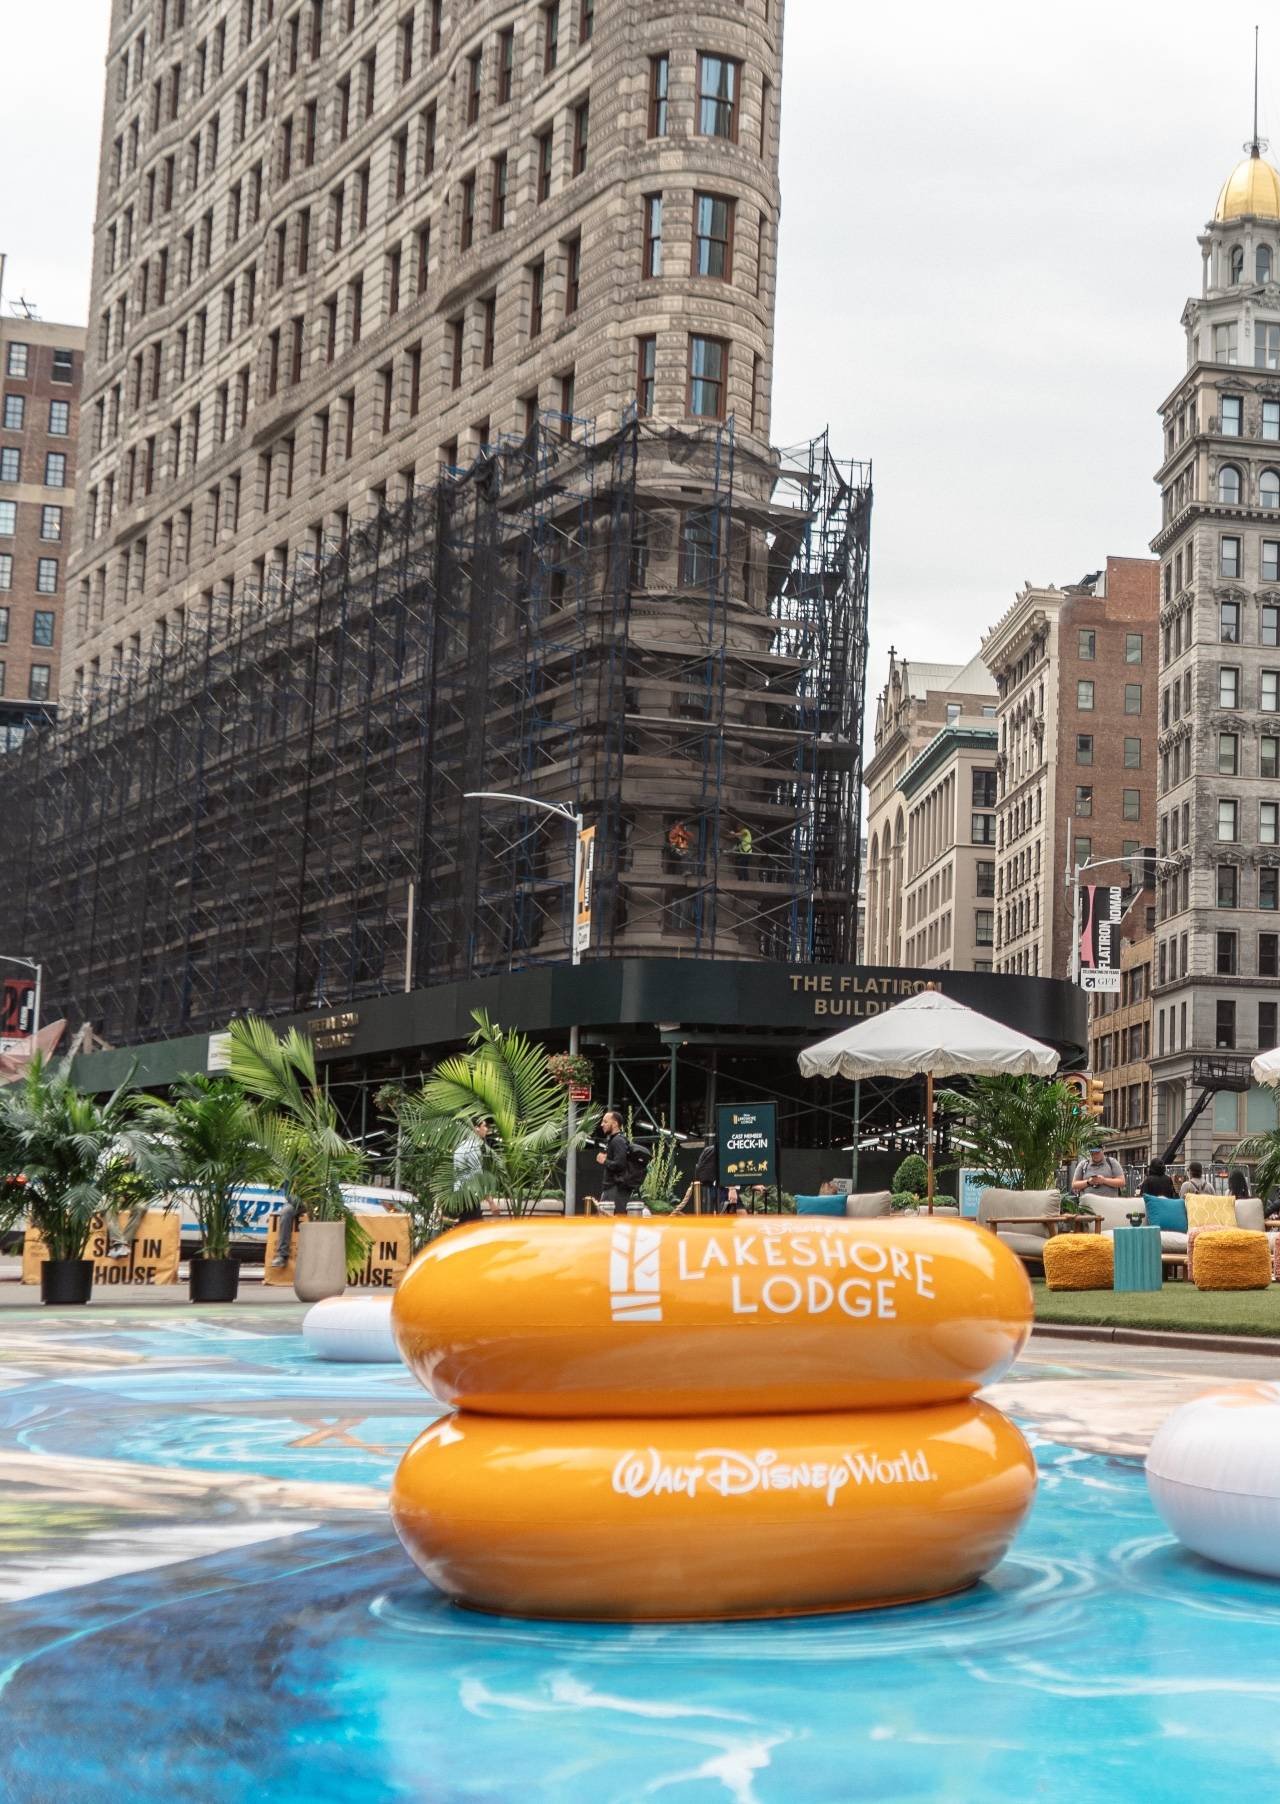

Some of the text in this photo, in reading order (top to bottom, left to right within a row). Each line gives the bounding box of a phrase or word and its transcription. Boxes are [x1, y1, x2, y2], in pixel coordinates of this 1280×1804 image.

[1110, 886, 1121, 924] NOMAD
[1099, 920, 1111, 969] FLATIRON
[790, 975, 832, 992] THE
[815, 999, 895, 1016] BUILDI
[727, 1138, 768, 1149] CHECK-IN
[143, 1239, 162, 1258] IN
[379, 1242, 398, 1260] IN
[95, 1266, 157, 1286] HOUSE
[347, 1268, 393, 1286] OUSE
[678, 1235, 936, 1300] LAKESHORE
[732, 1275, 897, 1319] LODGE
